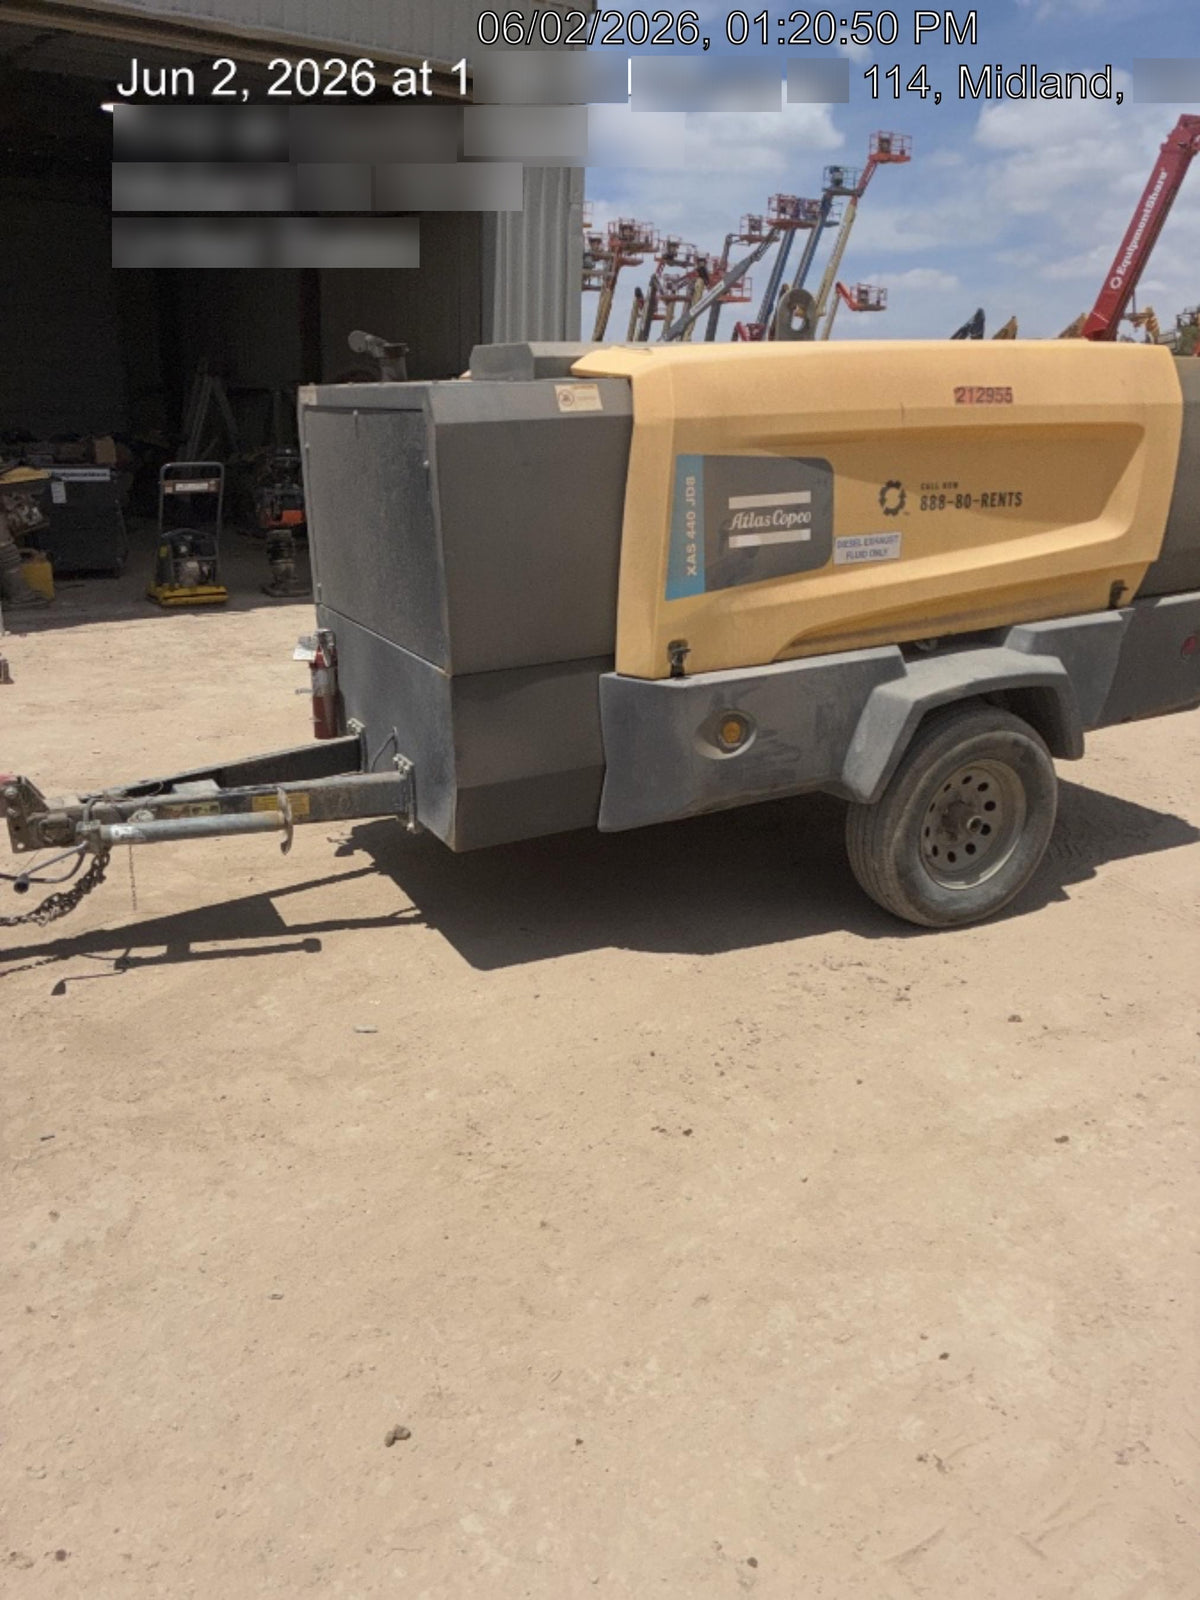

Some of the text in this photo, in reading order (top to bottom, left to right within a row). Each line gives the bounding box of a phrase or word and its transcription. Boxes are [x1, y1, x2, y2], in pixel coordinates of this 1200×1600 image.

[1116, 169, 1168, 276] EquipmentShare
[920, 491, 1023, 511] 888-80-RENTS
[686, 511, 696, 539] 440
[728, 509, 812, 530] Atlas Copco
[686, 543, 697, 577] XAS
